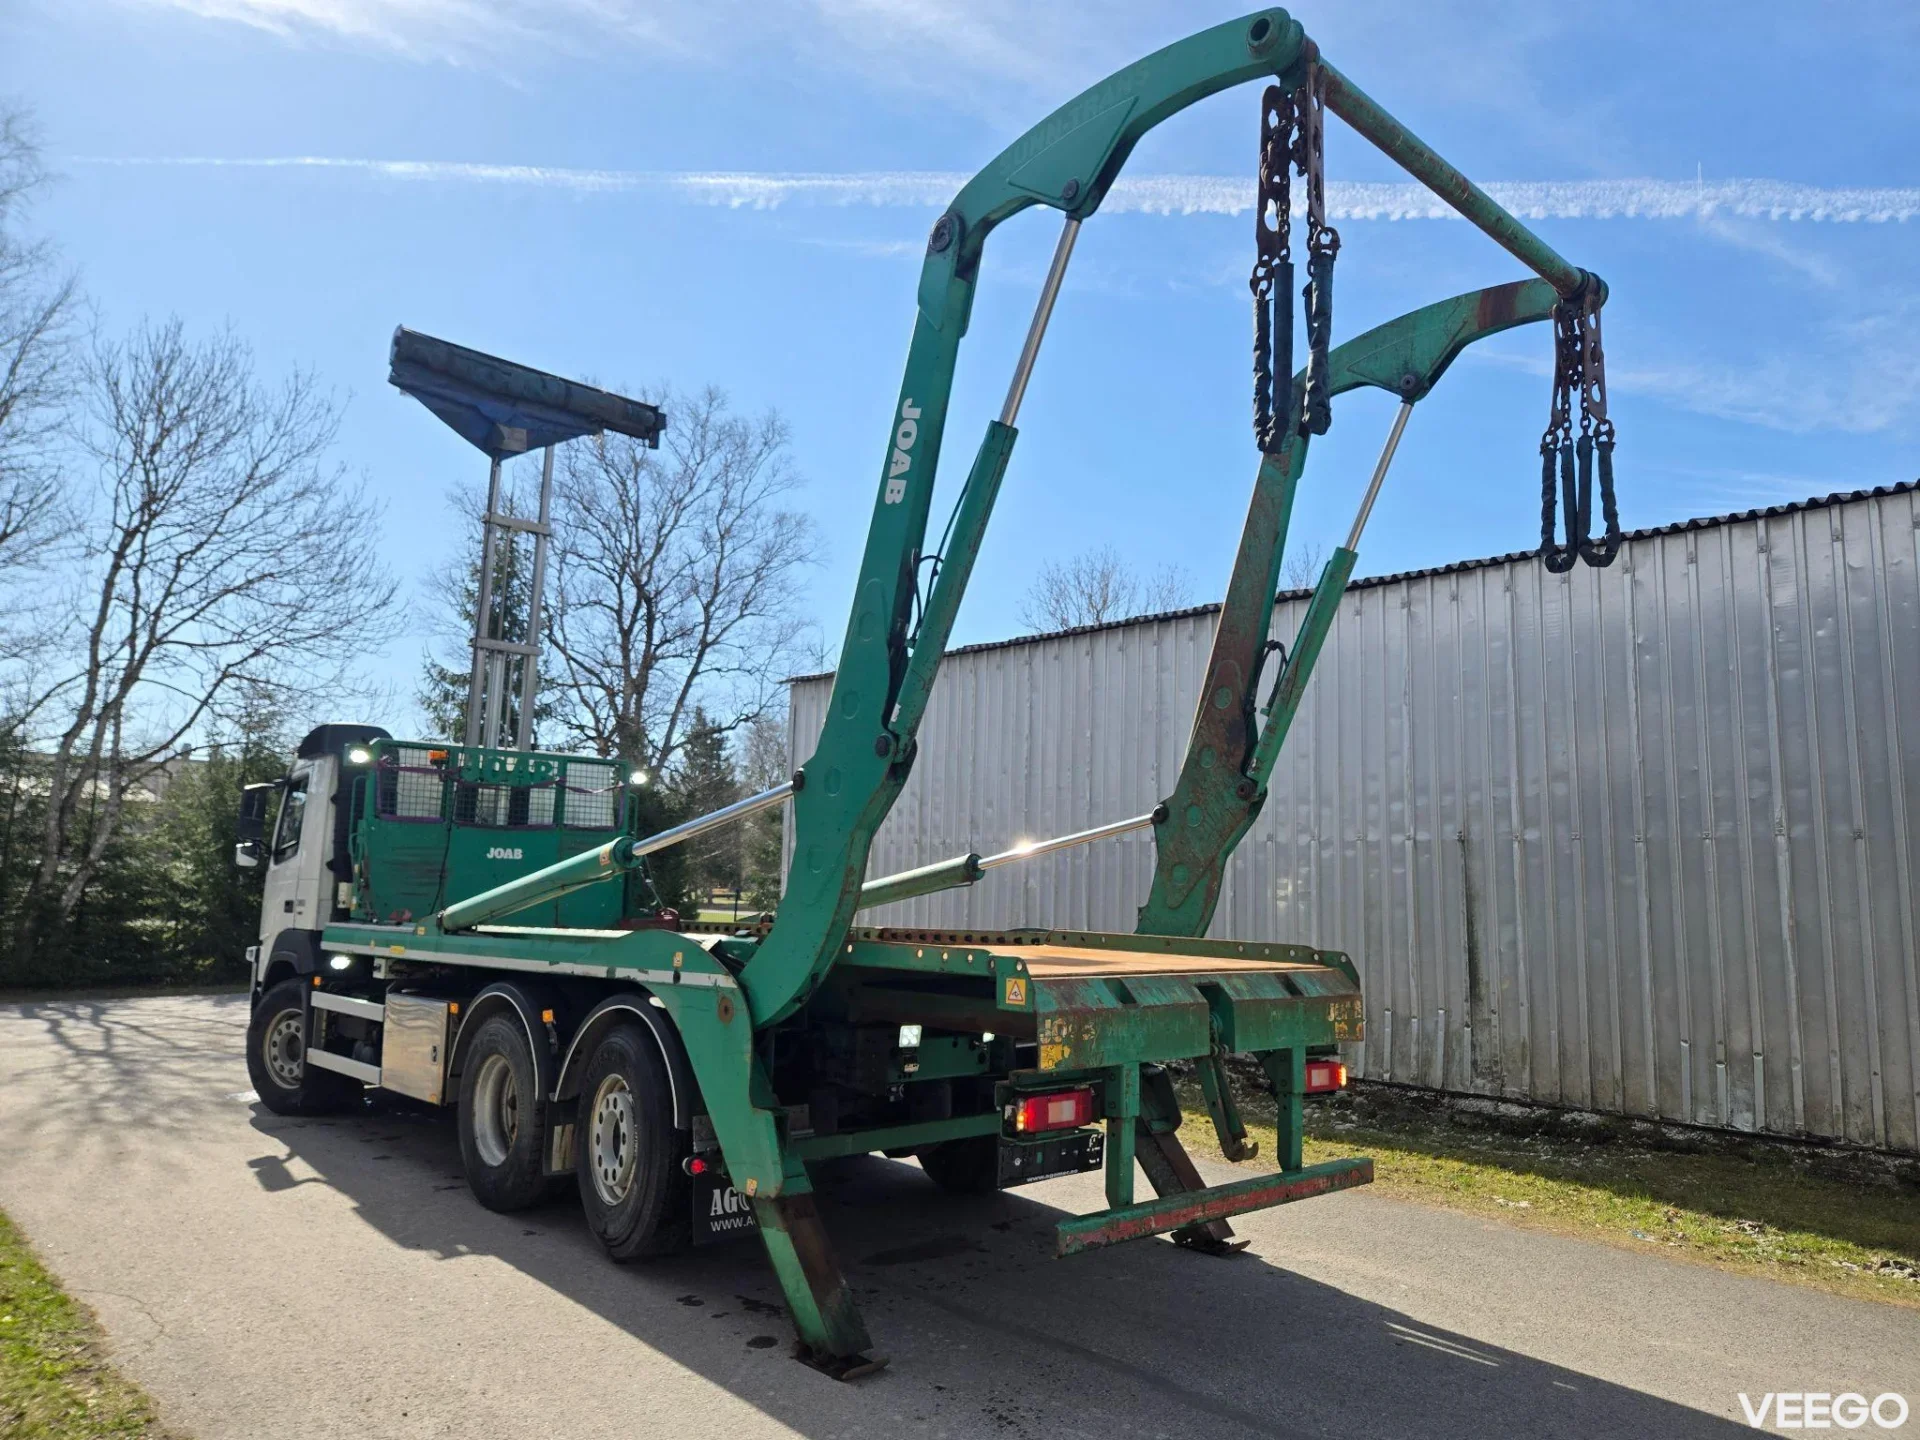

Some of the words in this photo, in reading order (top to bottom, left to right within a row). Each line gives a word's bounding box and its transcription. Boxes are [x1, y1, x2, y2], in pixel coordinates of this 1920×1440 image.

[885, 397, 922, 505] JOAB
[462, 754, 556, 786] JOAB
[486, 847, 523, 860] JOAB
[710, 1215, 756, 1232] WWW.A
